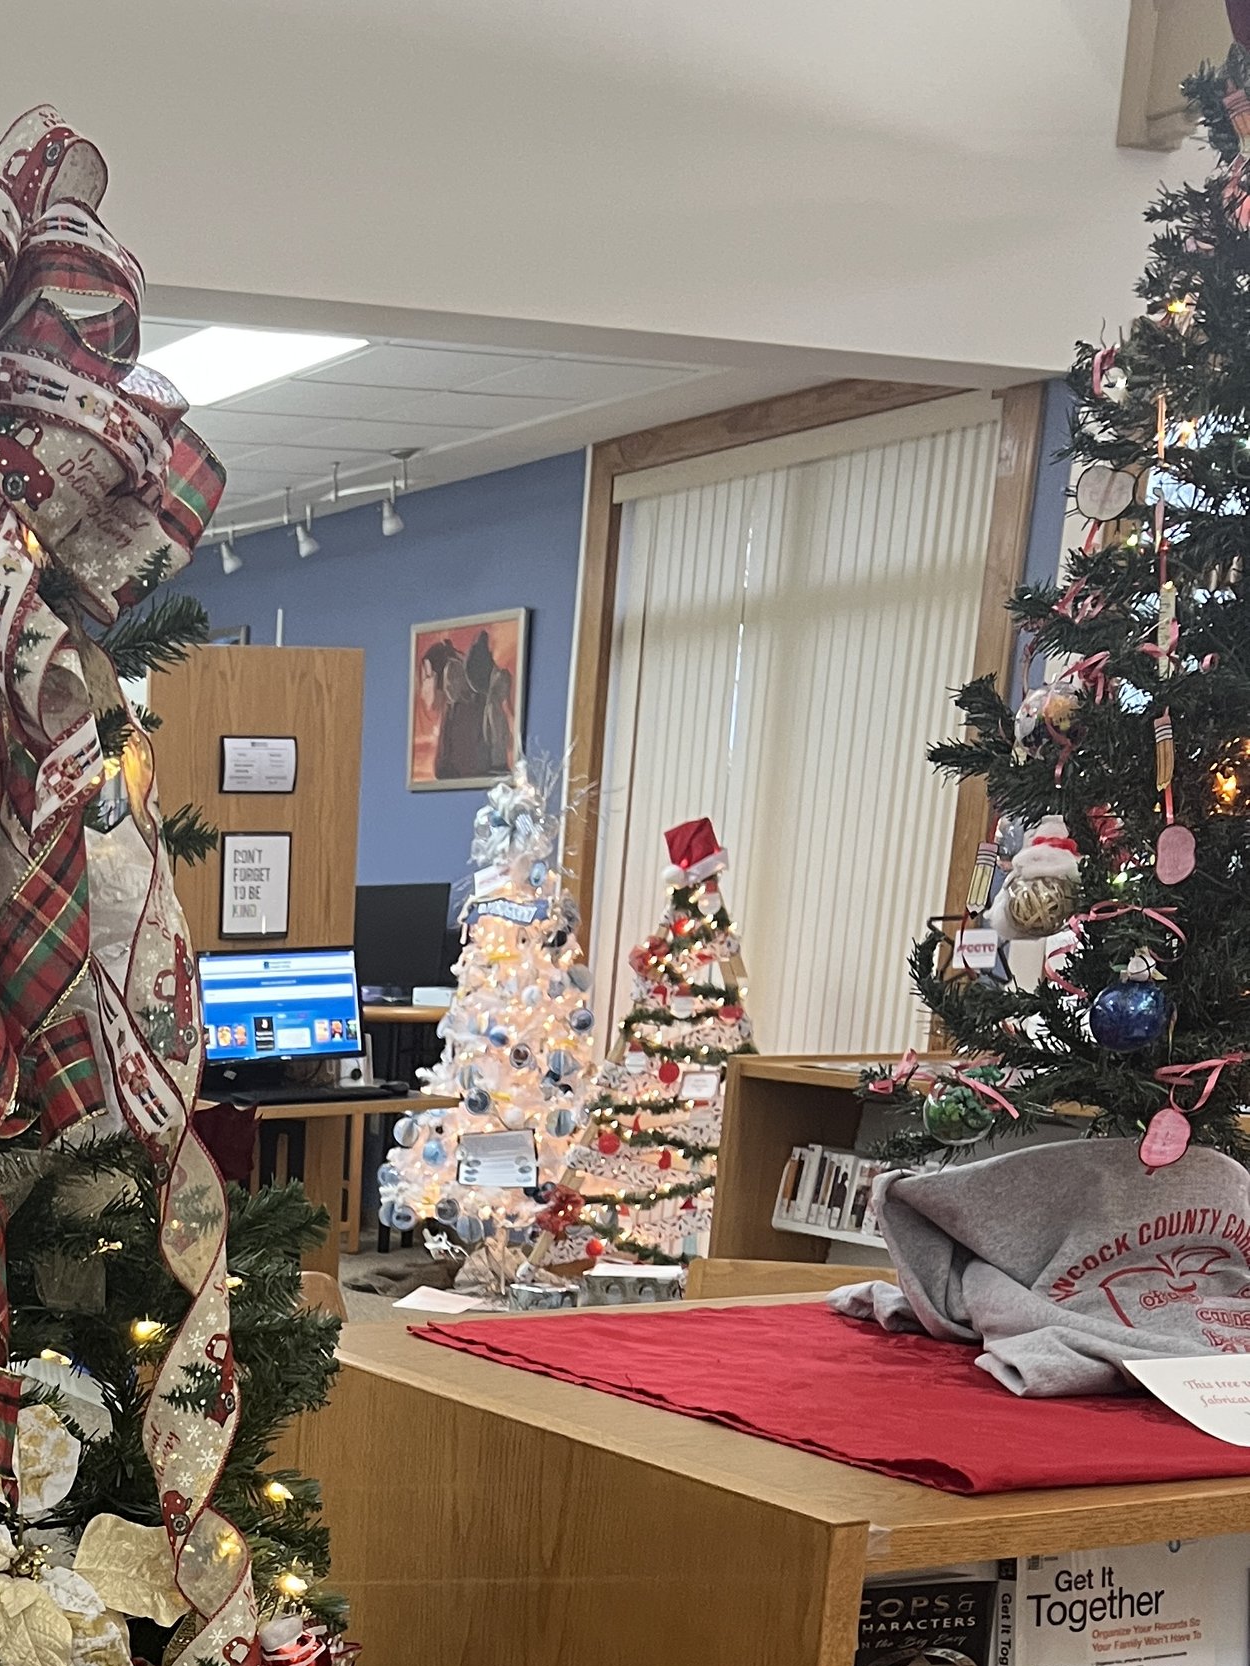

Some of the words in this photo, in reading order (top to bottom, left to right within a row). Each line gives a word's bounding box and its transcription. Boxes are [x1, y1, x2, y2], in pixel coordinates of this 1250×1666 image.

[233, 848, 262, 864] DON'T
[233, 867, 270, 883] FORGET
[233, 886, 247, 900] TO
[248, 886, 262, 900] BE
[232, 903, 258, 918] KIND
[1139, 1208, 1222, 1246] COUNTY
[1183, 1379, 1214, 1389] This
[1215, 1381, 1240, 1389] tree
[1055, 1568, 1094, 1592] Get
[1102, 1566, 1114, 1588] It
[1001, 1592, 1012, 1615] Get
[1027, 1586, 1165, 1633] Together
[862, 1616, 976, 1635] HARACTERS
[1001, 1616, 1012, 1634] It
[1092, 1627, 1131, 1639] Organize
[1133, 1624, 1152, 1634] Your
[1154, 1620, 1187, 1631] Records
[1092, 1643, 1111, 1652] Your
[1114, 1639, 1142, 1650] Family
[1144, 1635, 1169, 1645] Won't
[1171, 1633, 1191, 1642] Have
